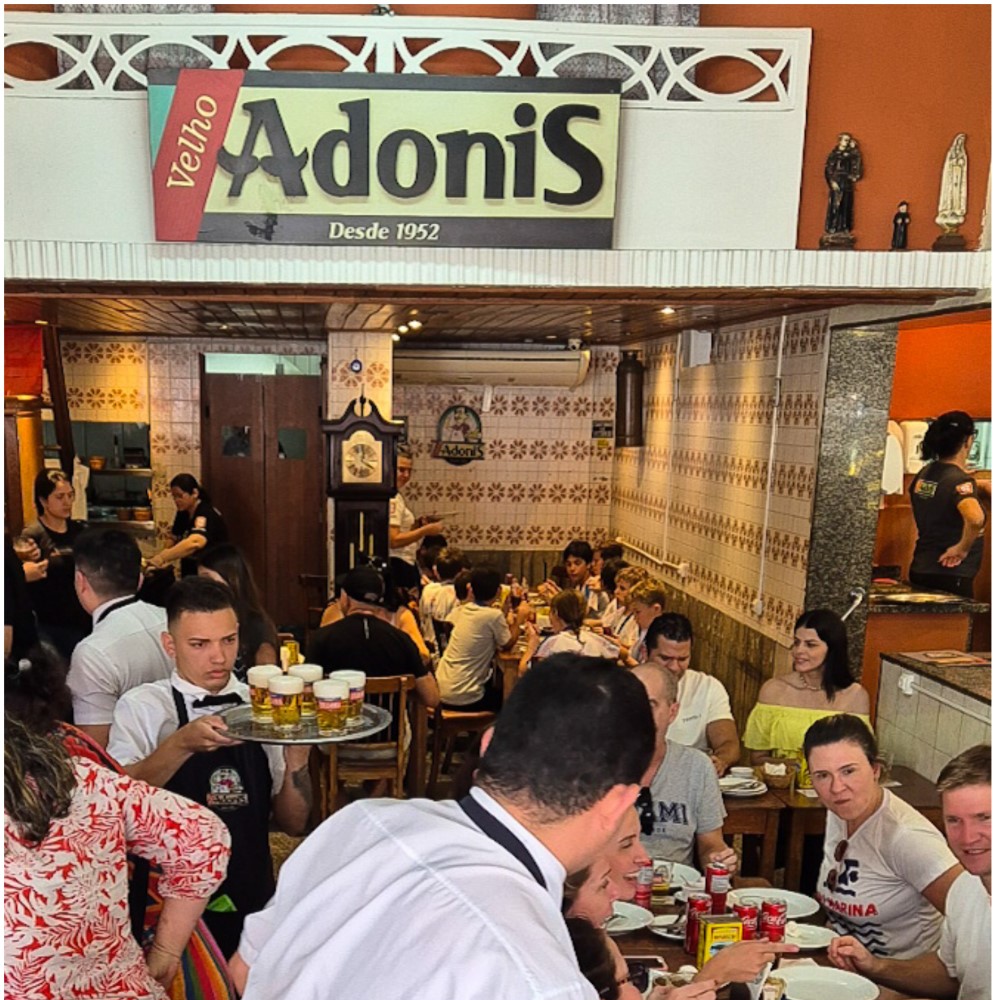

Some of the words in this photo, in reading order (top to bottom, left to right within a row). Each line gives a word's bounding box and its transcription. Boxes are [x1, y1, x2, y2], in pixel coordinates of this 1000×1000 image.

[166, 94, 218, 192] Velho
[216, 97, 606, 206] AdoniS
[328, 221, 390, 241] Desde
[396, 222, 440, 241] 1952
